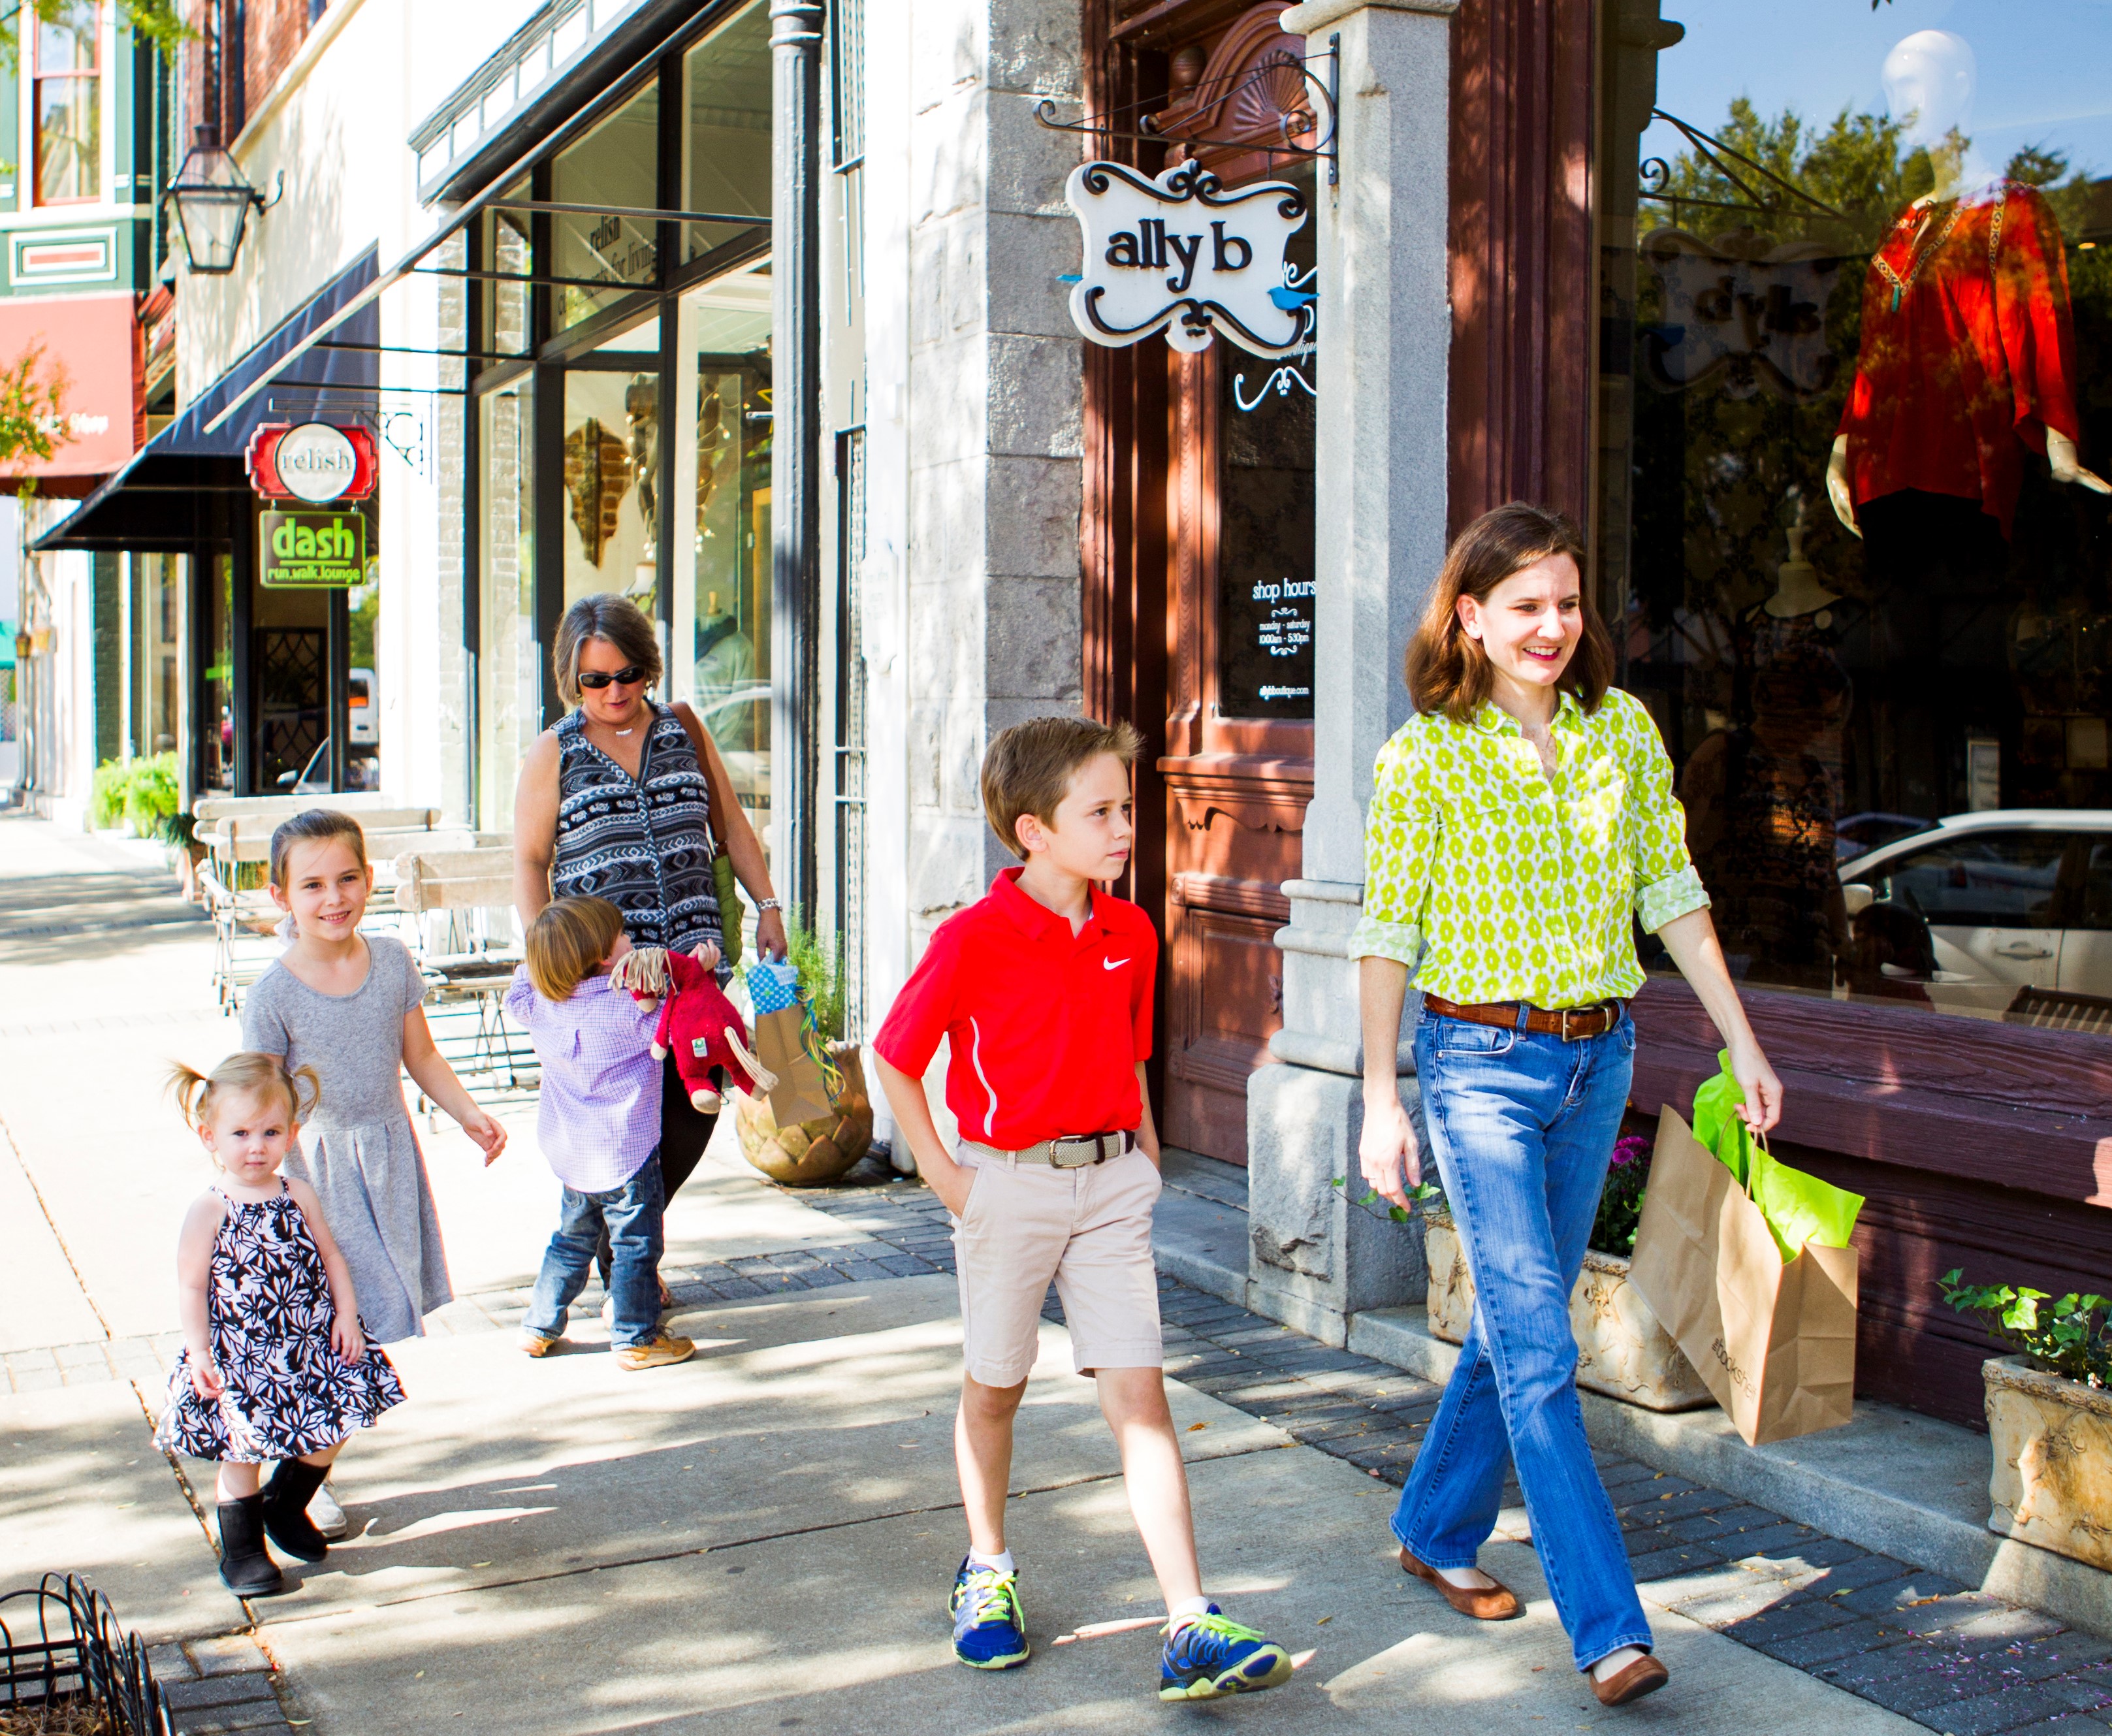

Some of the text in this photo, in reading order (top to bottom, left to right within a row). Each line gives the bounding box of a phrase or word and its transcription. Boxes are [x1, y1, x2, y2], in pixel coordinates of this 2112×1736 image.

[1104, 218, 1253, 293] ally b
[281, 447, 351, 470] relish
[272, 517, 356, 560] dash
[1253, 577, 1316, 603] shop hours
[1259, 620, 1281, 633] monday
[1286, 619, 1311, 633] saturday
